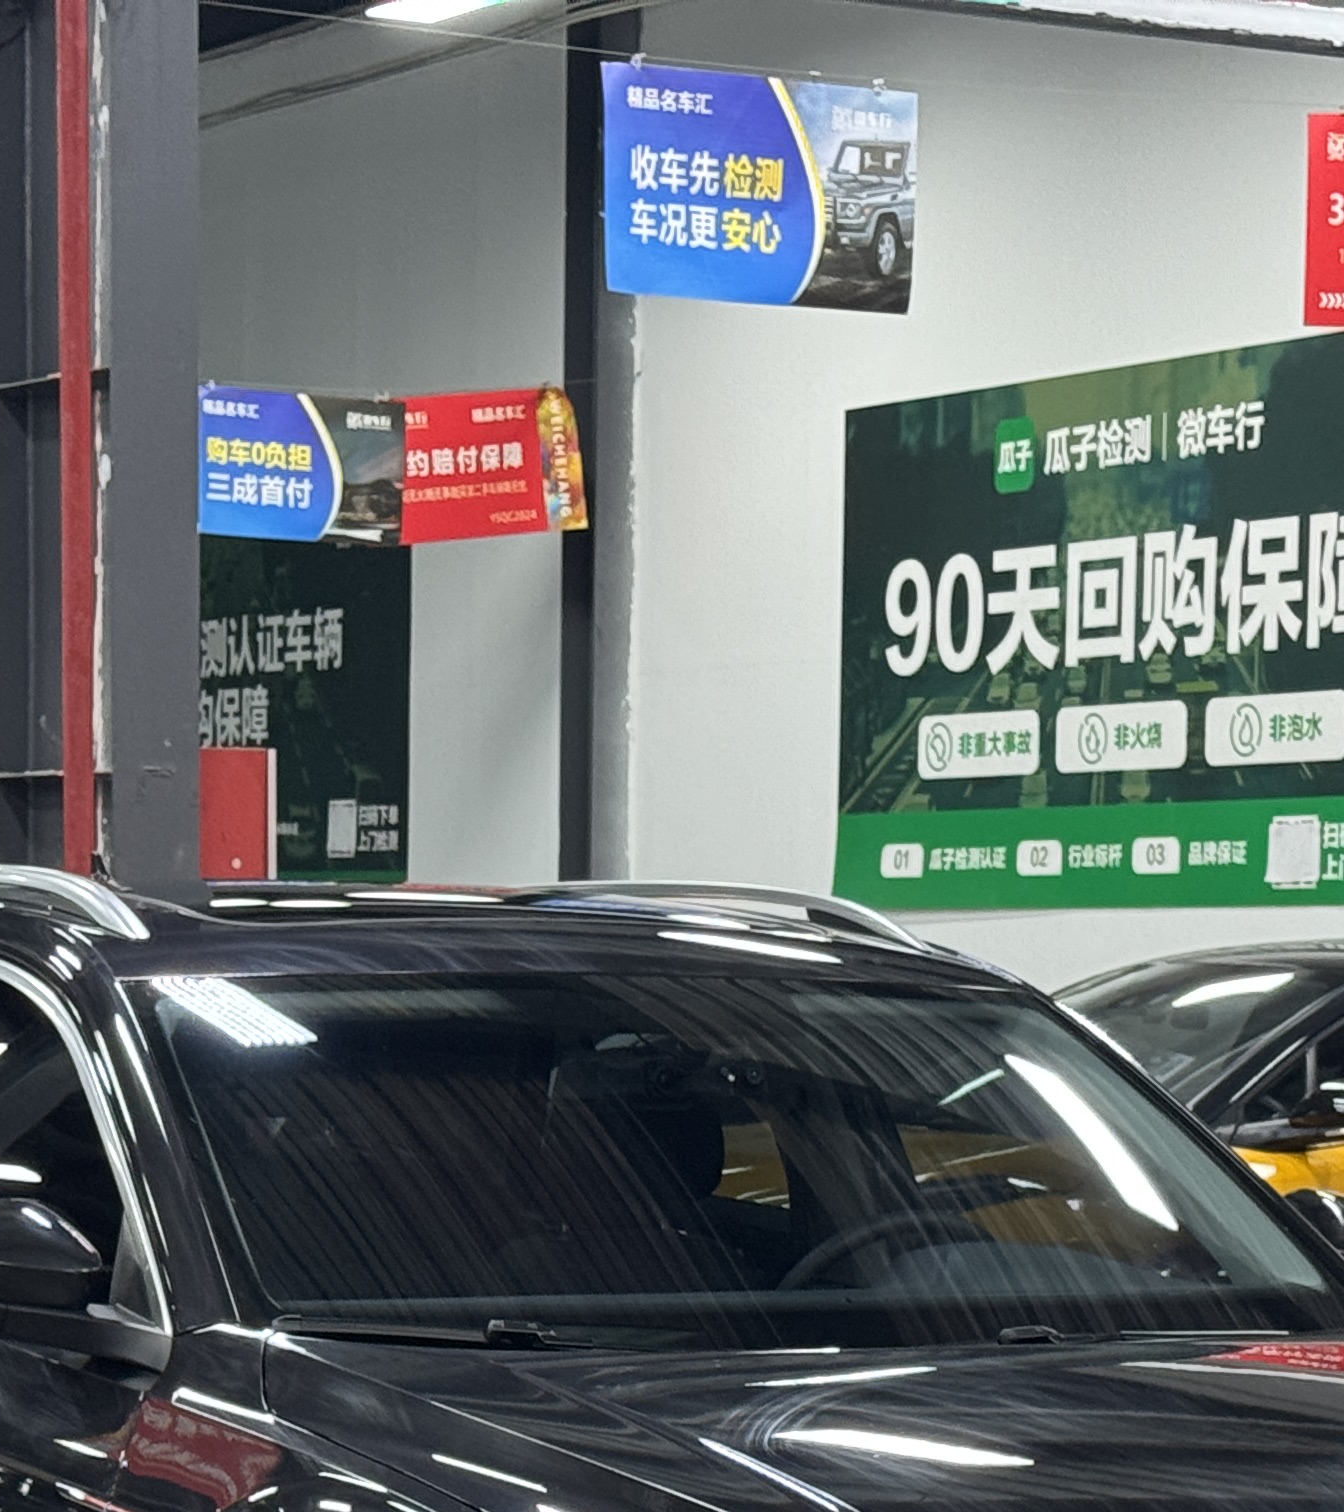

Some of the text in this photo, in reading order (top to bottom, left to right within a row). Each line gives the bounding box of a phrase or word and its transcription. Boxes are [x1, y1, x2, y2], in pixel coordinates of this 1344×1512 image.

[627, 86, 713, 115] 精品名车汇
[631, 145, 784, 202] 收车先检测
[630, 198, 782, 254] 车况更安心
[998, 401, 1265, 475] 瓜子 瓜子检测 微车行
[206, 436, 312, 472] 购车0负担
[206, 472, 313, 509] 三成首付
[1114, 721, 1162, 750] 非火烧
[1269, 712, 1323, 742] 非泡水
[958, 730, 1032, 758] 非重大事故
[893, 849, 910, 870] 01
[1030, 846, 1049, 867] 02
[1146, 843, 1166, 865] 03
